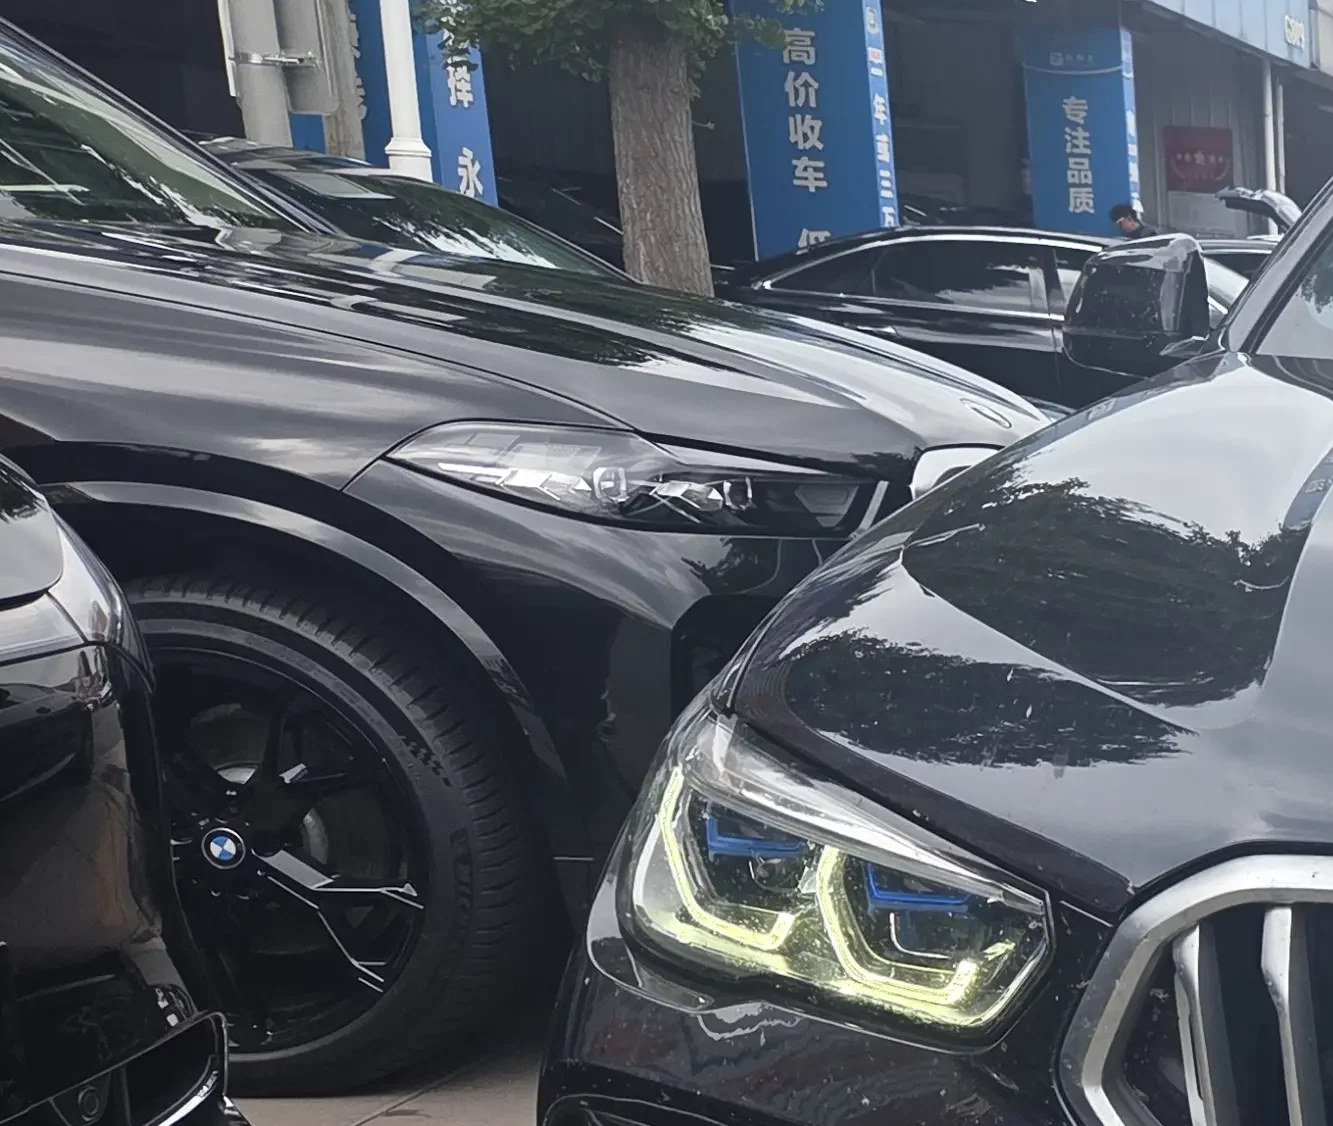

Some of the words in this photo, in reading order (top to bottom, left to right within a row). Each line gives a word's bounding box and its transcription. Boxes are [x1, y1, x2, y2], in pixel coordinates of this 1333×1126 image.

[781, 27, 829, 193] 高价收车
[1061, 95, 1096, 214] 专注品质
